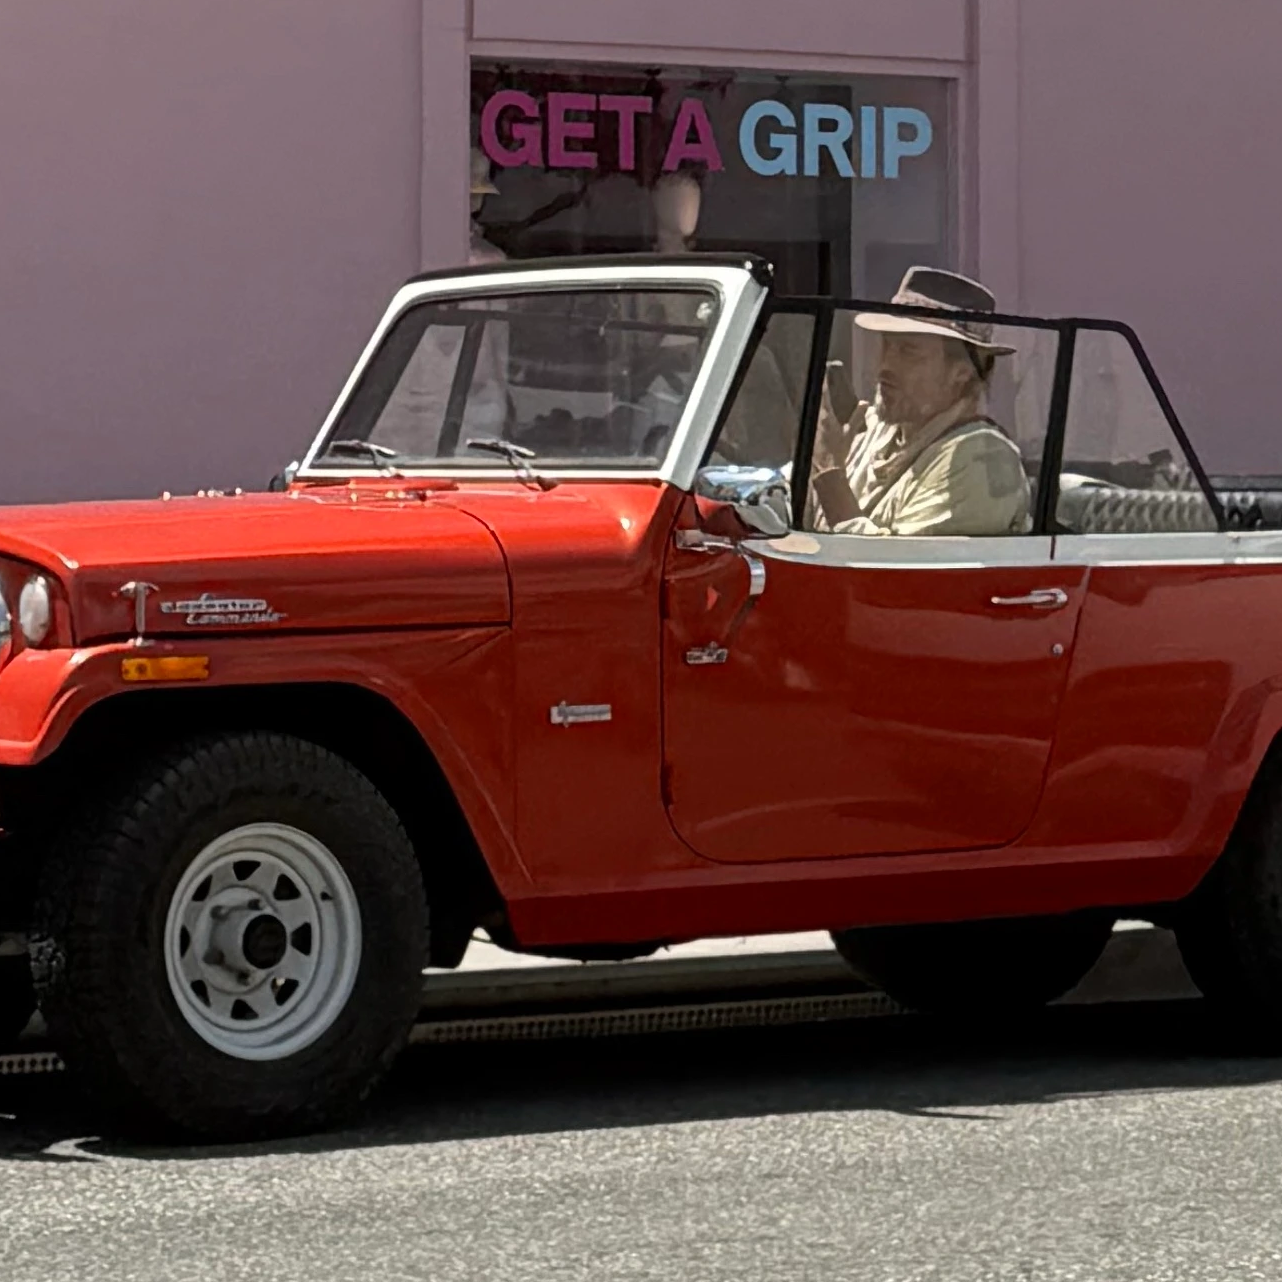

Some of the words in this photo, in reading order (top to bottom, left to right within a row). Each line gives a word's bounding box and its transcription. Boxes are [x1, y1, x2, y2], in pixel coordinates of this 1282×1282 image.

[480, 90, 652, 171] GET
[663, 98, 725, 171] A
[739, 100, 933, 179] GRIP
